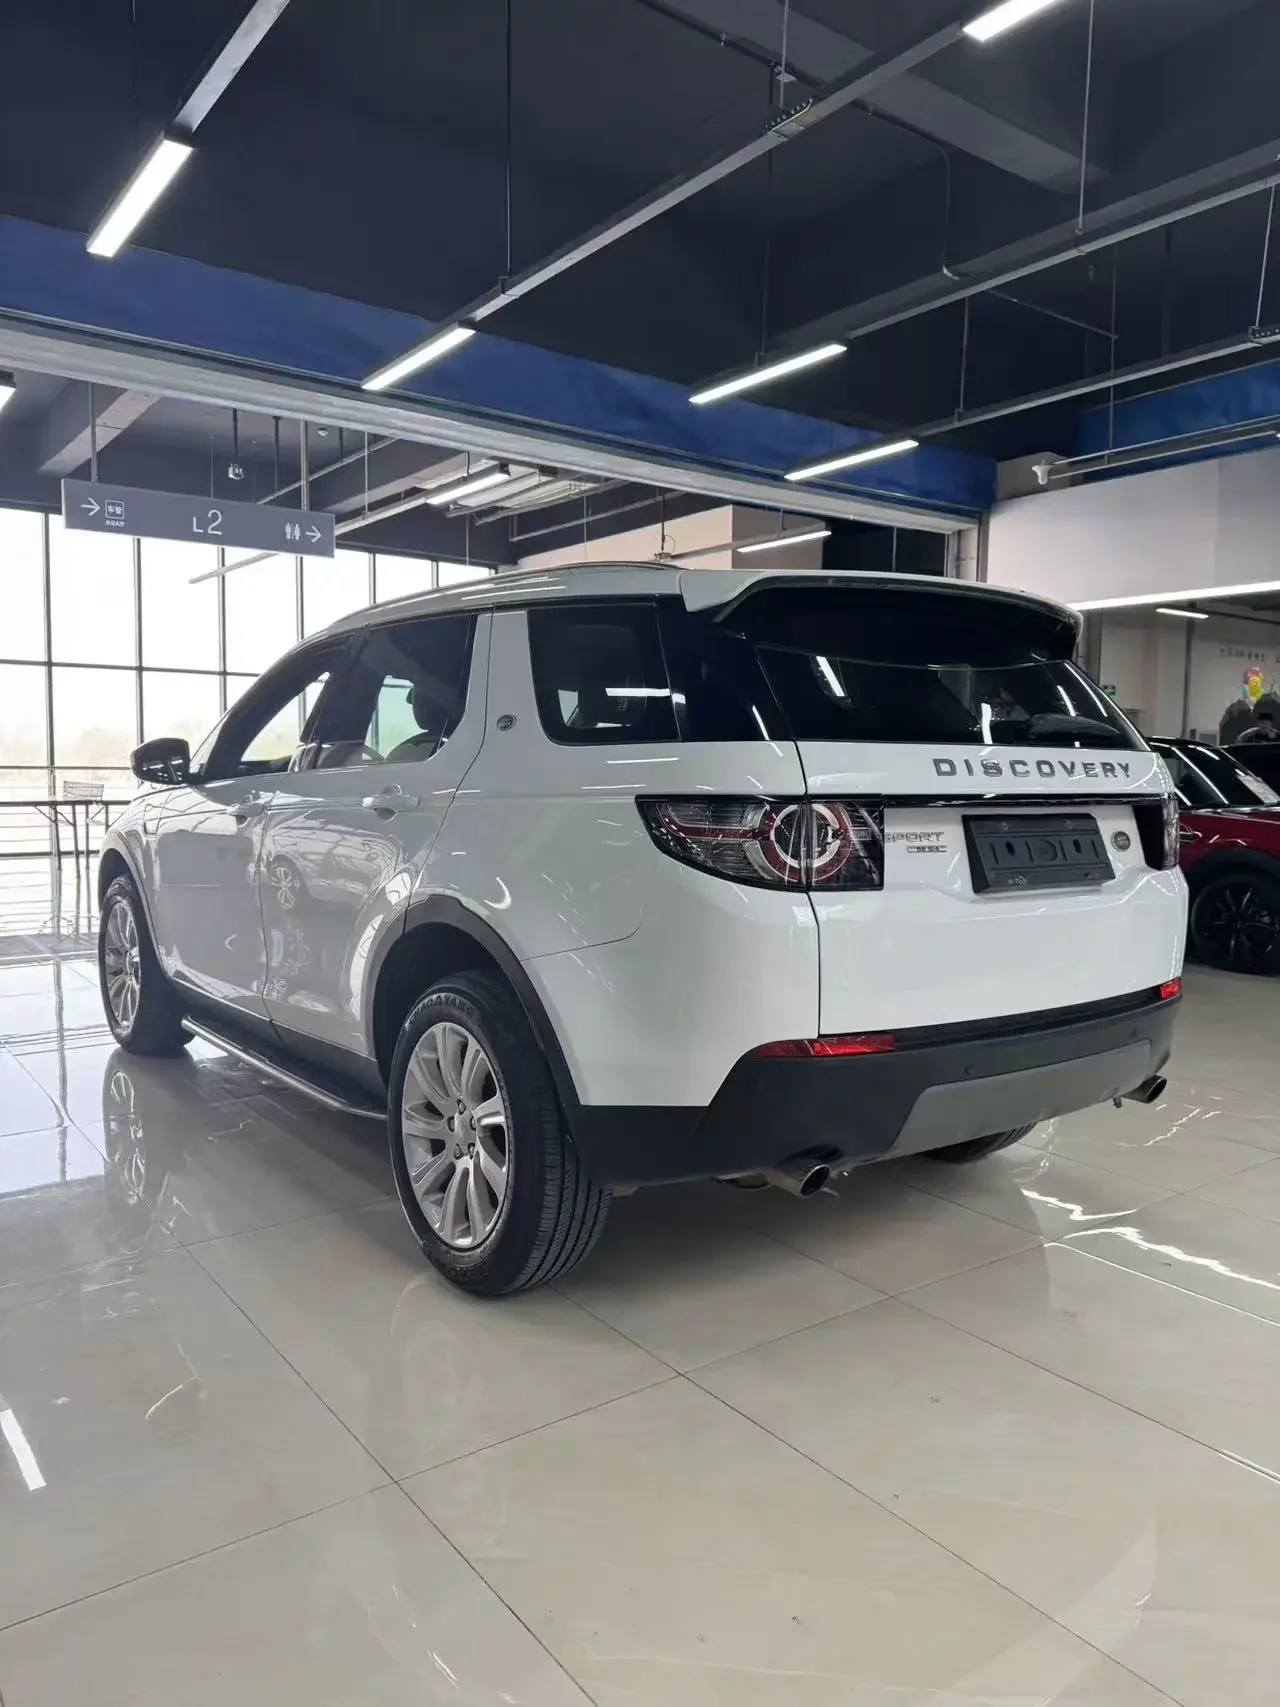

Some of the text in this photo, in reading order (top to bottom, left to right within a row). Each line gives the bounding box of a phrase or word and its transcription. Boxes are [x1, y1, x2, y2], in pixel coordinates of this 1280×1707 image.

[193, 509, 222, 536] L2
[933, 758, 1131, 778] DISCOVERY
[884, 831, 945, 843] SPORT
